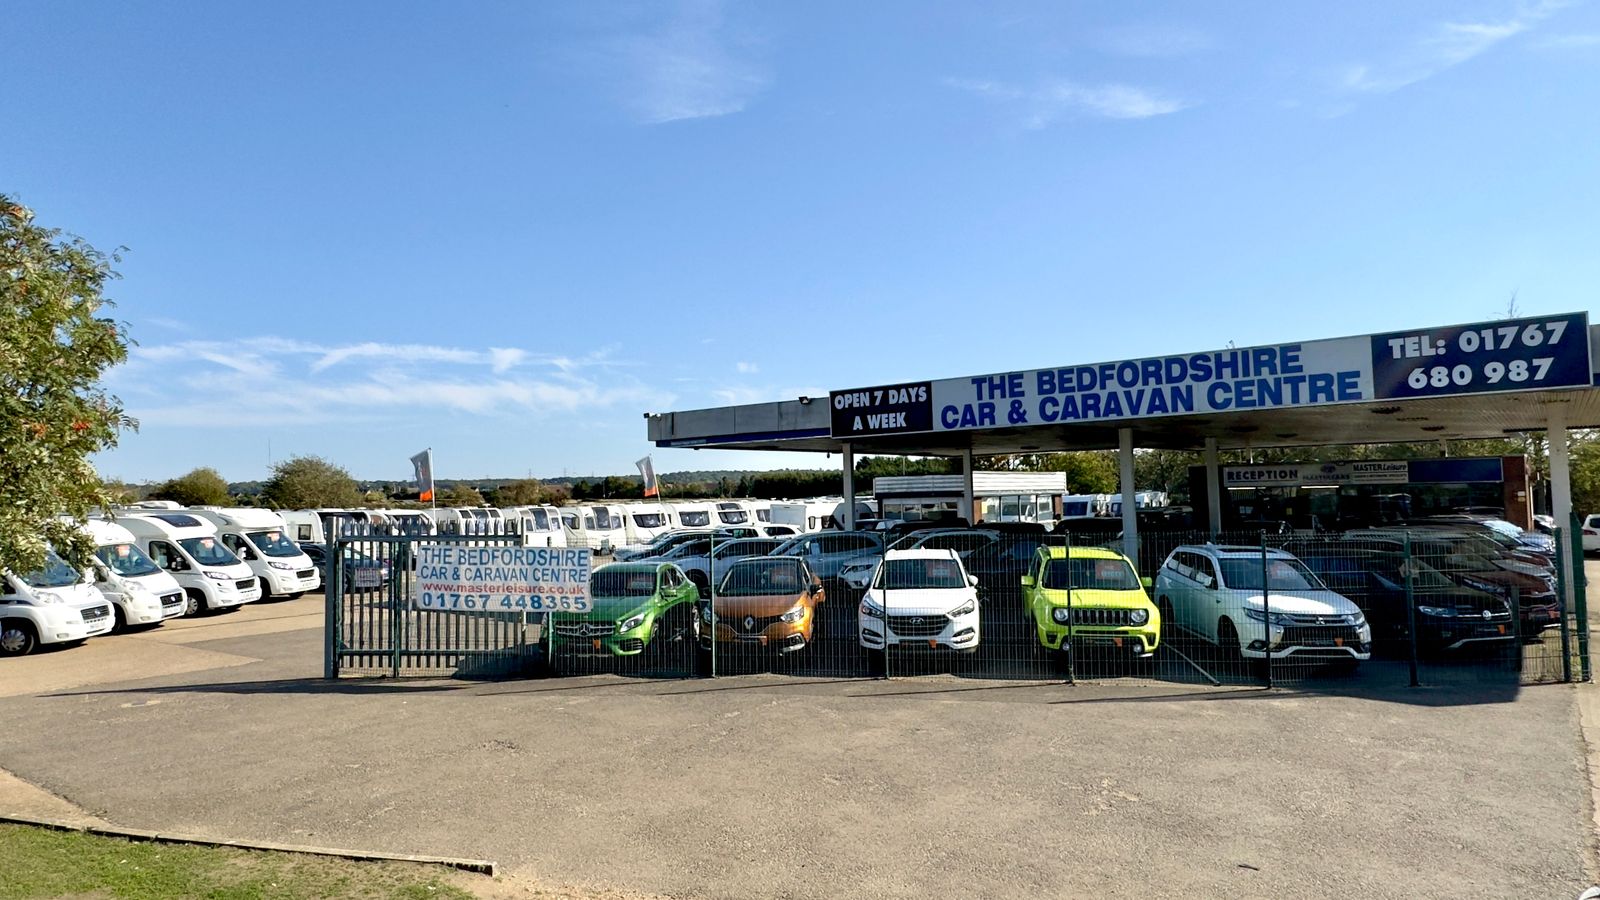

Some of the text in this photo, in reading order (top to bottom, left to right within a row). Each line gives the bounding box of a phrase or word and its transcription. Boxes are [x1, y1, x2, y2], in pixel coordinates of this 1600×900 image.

[1388, 320, 1569, 360] TEL: 01767
[971, 344, 1304, 401] THE BEDFORDSHIRE
[1407, 356, 1555, 390] 680 987
[834, 386, 927, 410] OPEN 7 DAYS
[940, 370, 1363, 430] CAR & CARAVAN CENTRE
[852, 411, 907, 431] A WEEK
[1227, 469, 1298, 481] RECEPTION
[421, 547, 588, 567] THE BEDFORDSHIRE
[420, 565, 588, 583] CAR & CARAVAN CENTRE
[422, 582, 585, 595] www.masterleisure.co.uk
[422, 592, 587, 611] 01767 448365
